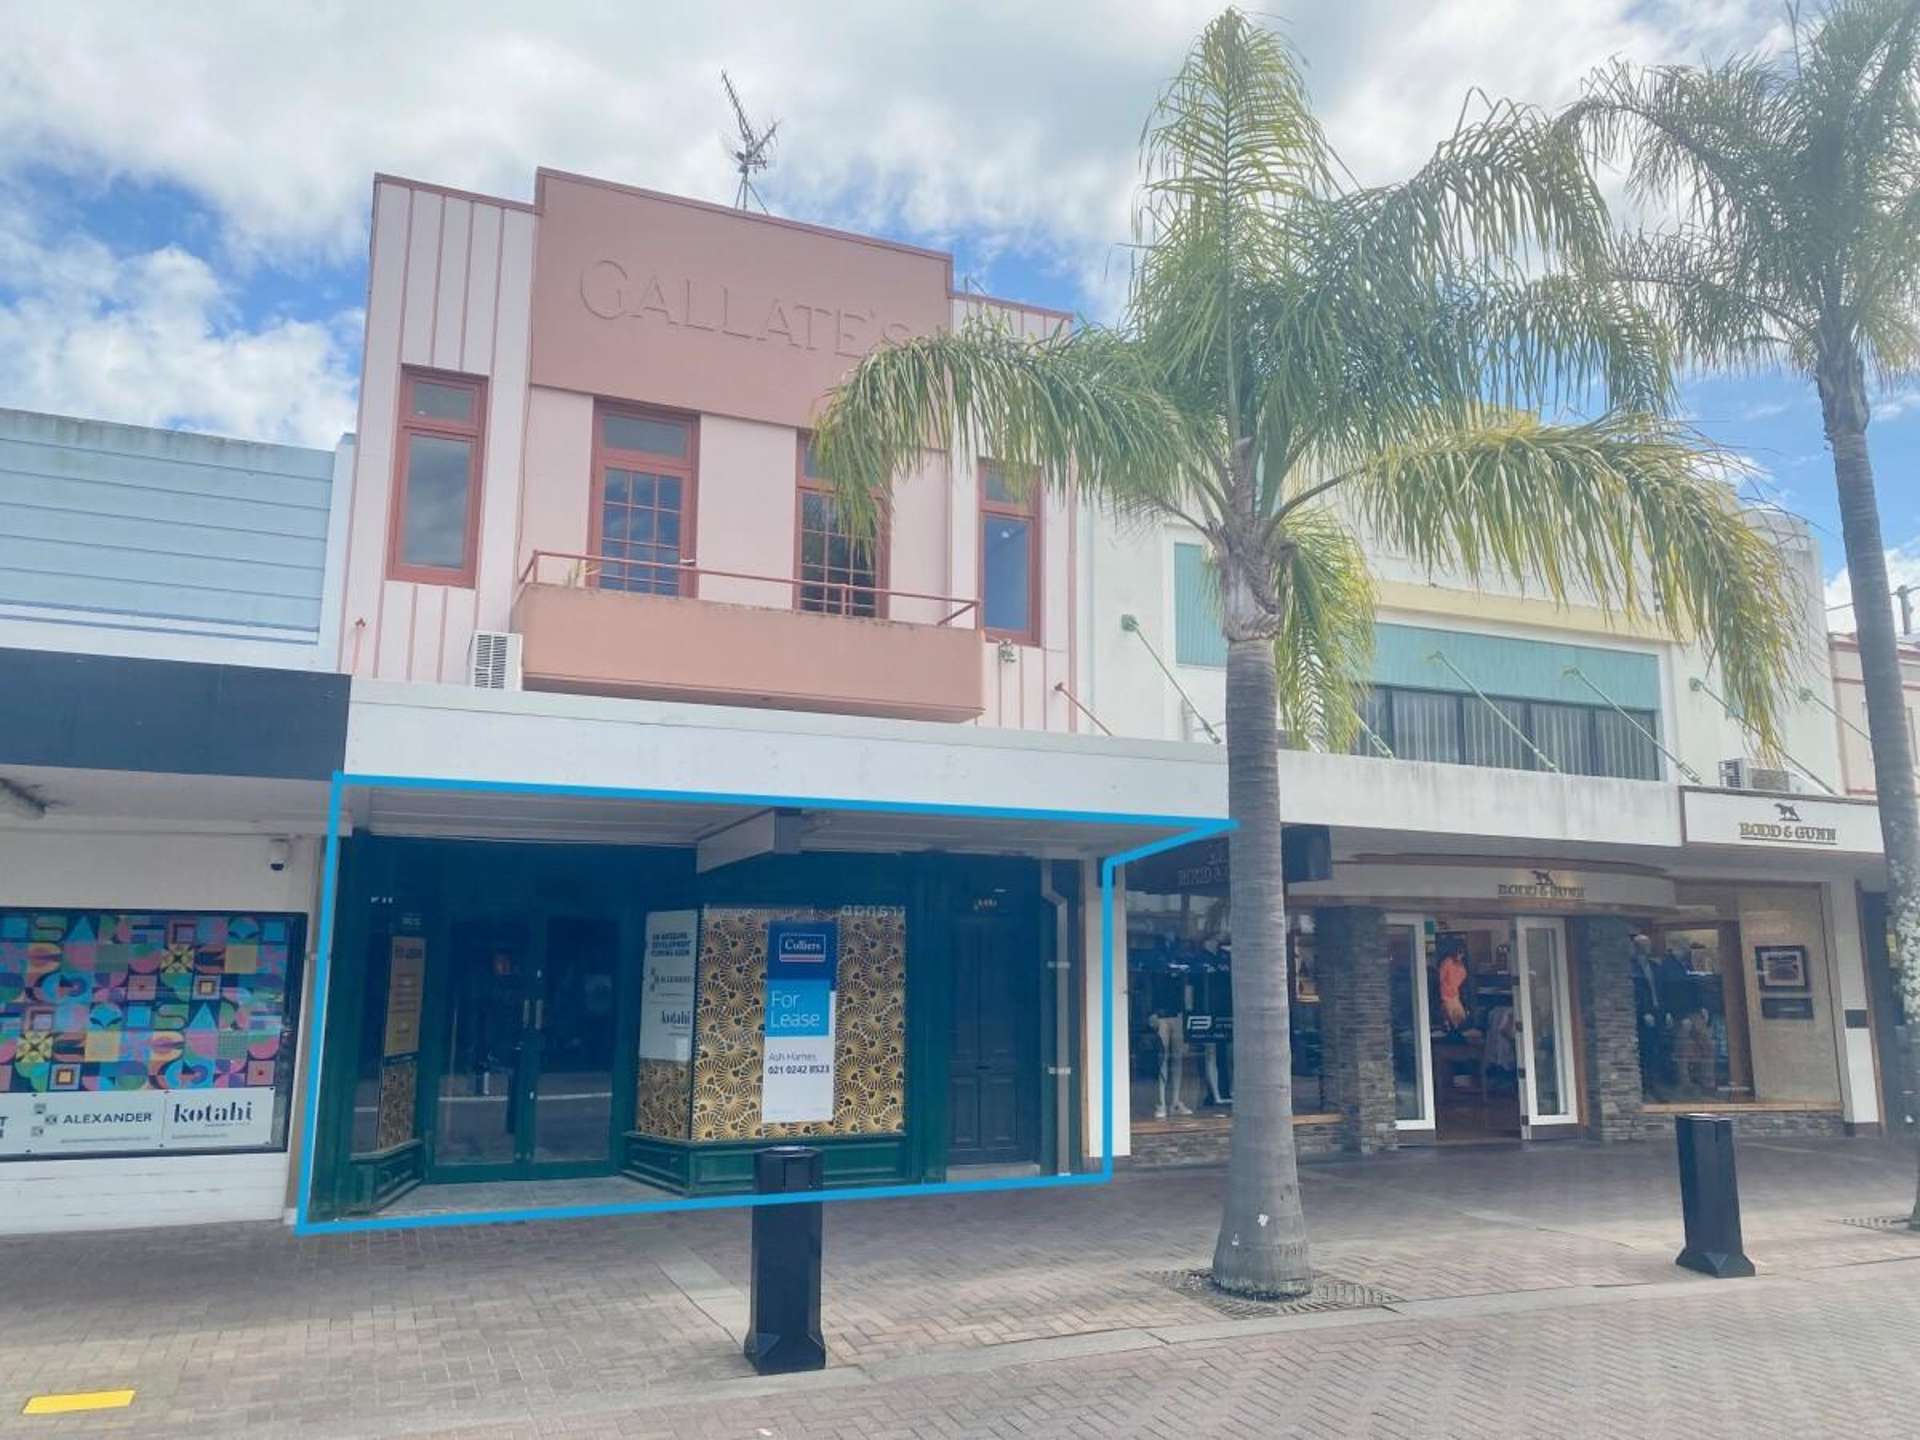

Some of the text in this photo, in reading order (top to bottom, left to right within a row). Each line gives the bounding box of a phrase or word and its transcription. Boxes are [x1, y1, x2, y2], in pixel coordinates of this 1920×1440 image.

[1739, 822, 1837, 841] RODD & GUNN
[784, 938, 821, 951] Colliers
[771, 990, 800, 1009] For
[769, 1011, 820, 1028] Lease
[768, 1065, 784, 1075] 021
[63, 1101, 254, 1125] ALEXANDER kotahi
